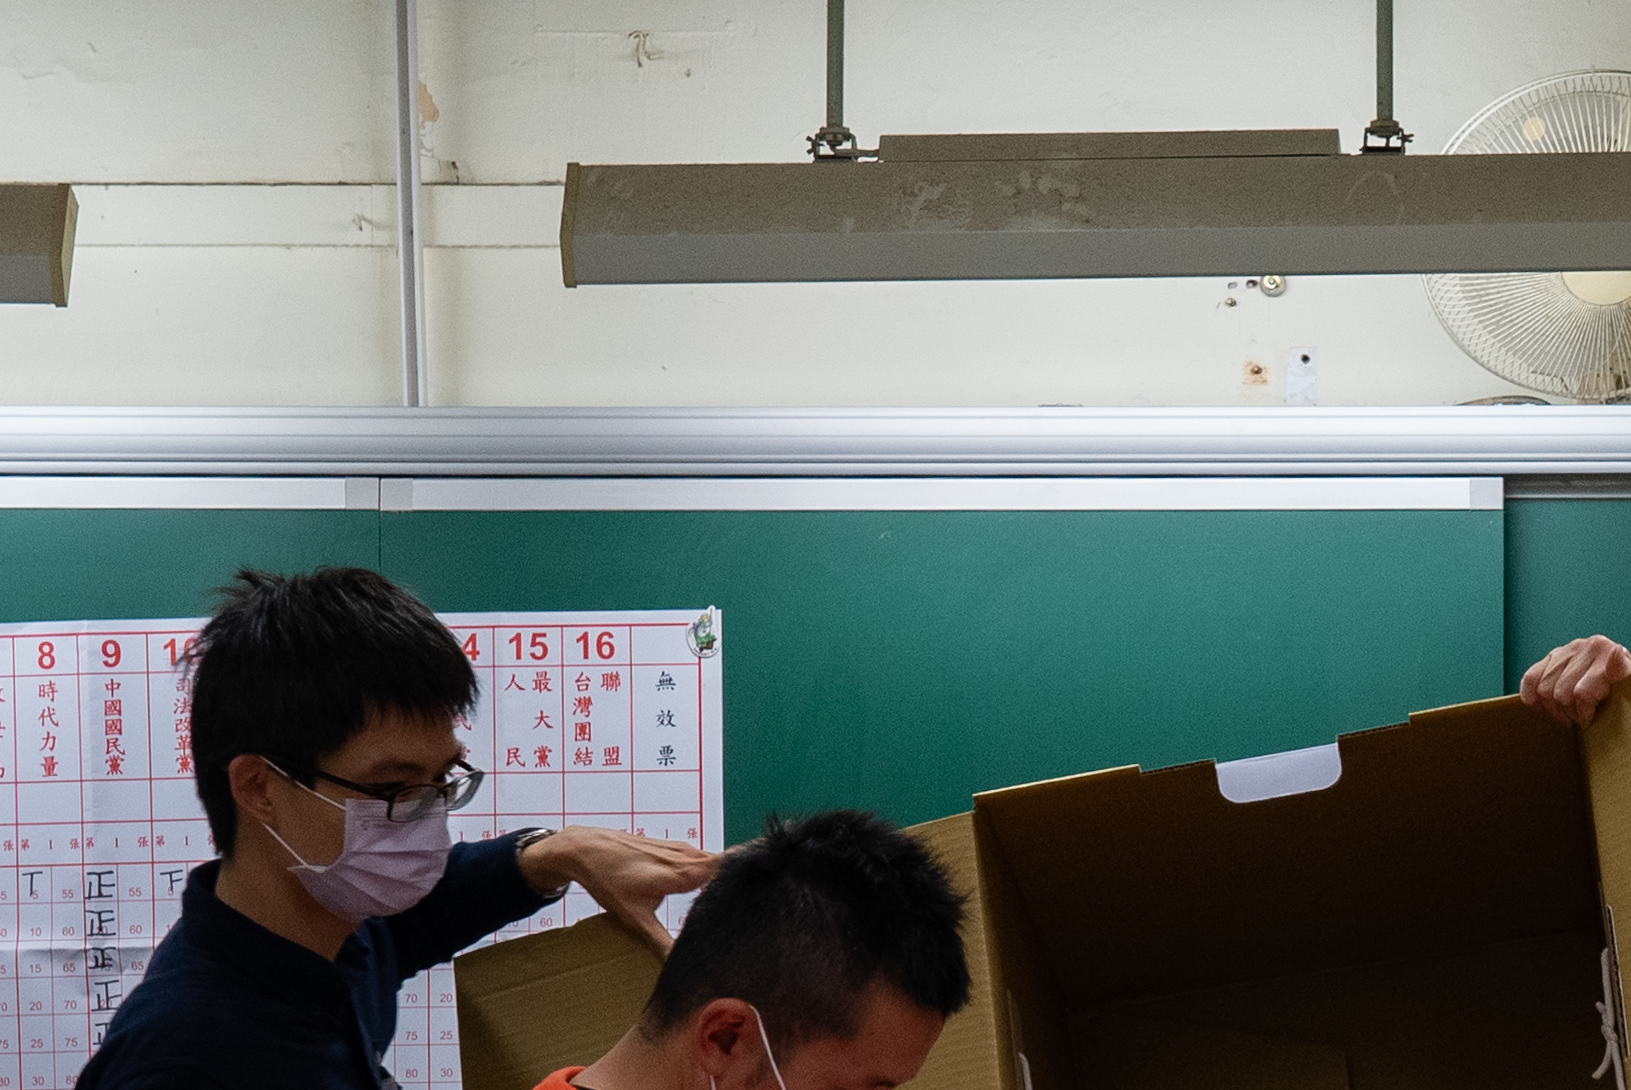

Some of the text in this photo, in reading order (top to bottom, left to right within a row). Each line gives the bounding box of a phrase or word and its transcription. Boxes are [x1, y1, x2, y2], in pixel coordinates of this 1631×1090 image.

[508, 632, 548, 660] 15
[575, 631, 615, 660] 16
[38, 642, 56, 670] 8
[101, 640, 121, 668] 9
[572, 672, 593, 766] 台灣團結
[600, 671, 622, 766] 聯盟
[655, 671, 676, 766] 無效票
[38, 680, 59, 778] 時代力量
[104, 678, 125, 776] 中國國民黨
[688, 828, 698, 839] 張
[3, 840, 14, 851] 張
[21, 838, 80, 850] 第 1 張
[86, 836, 149, 848] 第 1 張
[156, 835, 189, 847] 第 1
[84, 870, 116, 900] 正
[62, 890, 74, 898] 55
[129, 888, 142, 897] 55
[84, 910, 116, 937] 正
[540, 917, 553, 928] 60
[30, 928, 42, 937] 10
[62, 927, 74, 936] 60
[130, 925, 142, 934] 60
[89, 947, 116, 969] 正
[30, 964, 42, 974] 15
[63, 964, 76, 973] 65
[131, 961, 144, 971] 65
[91, 980, 122, 1012] 正
[406, 993, 418, 1004] 70
[440, 993, 453, 1003] 20
[30, 1001, 42, 1011] 20
[64, 1000, 77, 1010] 70
[406, 1030, 418, 1041] 75
[440, 1030, 453, 1041] 25
[30, 1038, 44, 1048] 25
[65, 1038, 78, 1048] 75
[406, 1068, 418, 1078] 80
[440, 1068, 453, 1078] 30
[32, 1076, 44, 1086] 30
